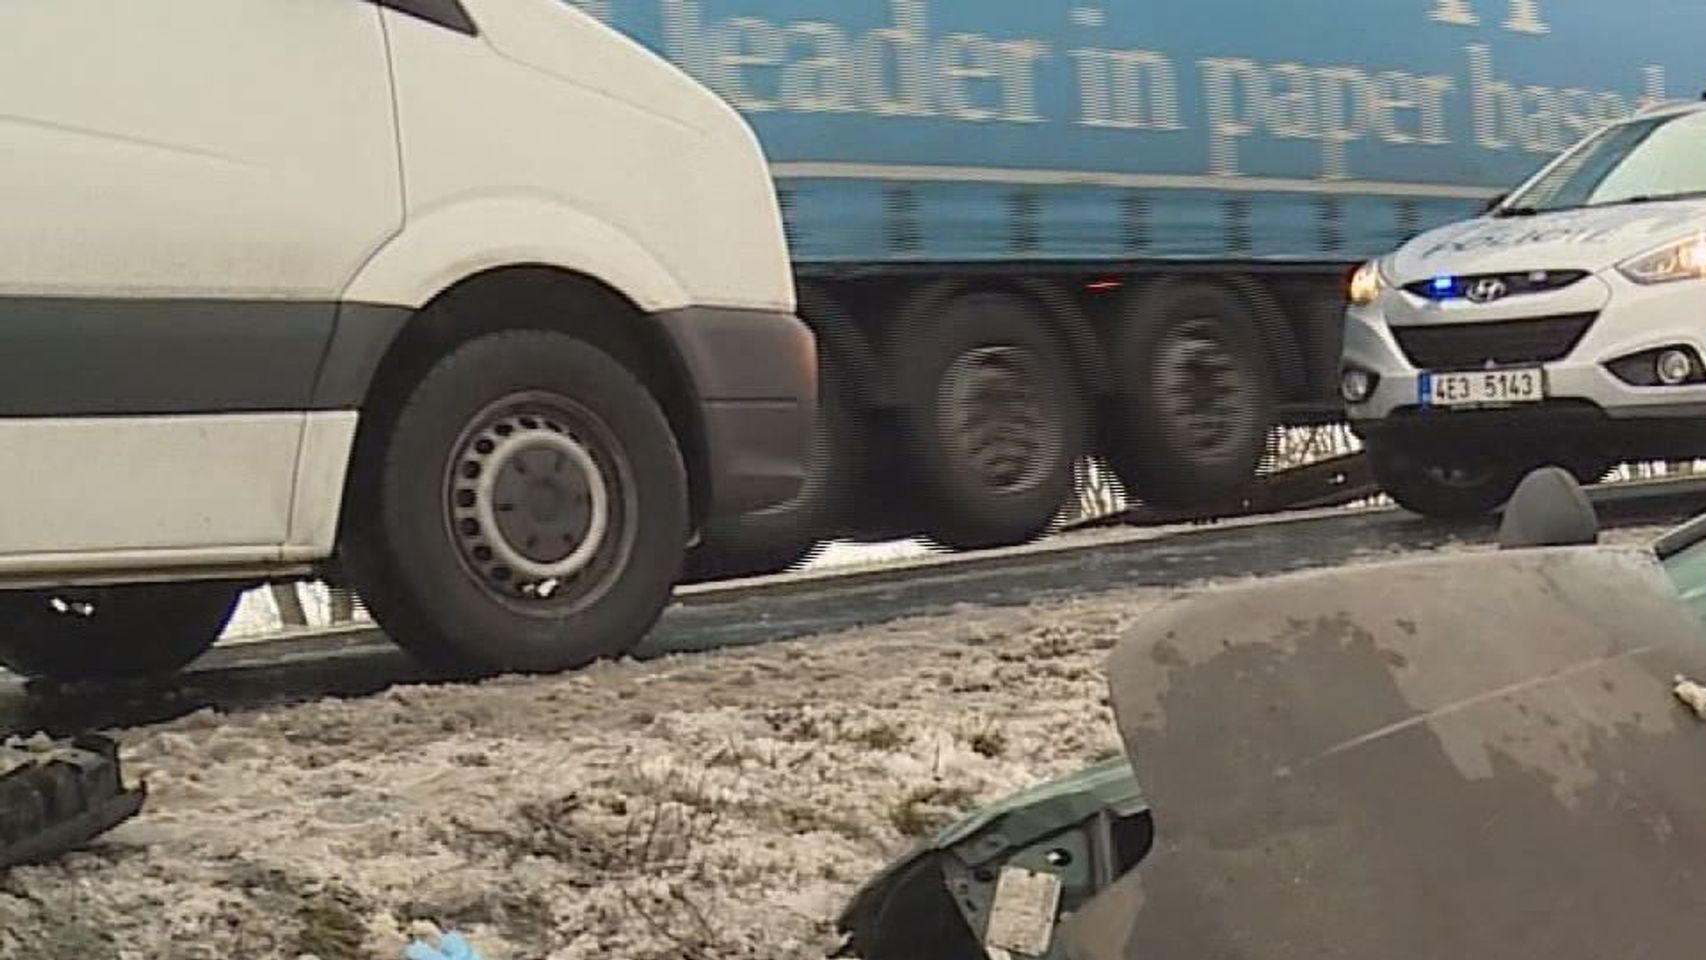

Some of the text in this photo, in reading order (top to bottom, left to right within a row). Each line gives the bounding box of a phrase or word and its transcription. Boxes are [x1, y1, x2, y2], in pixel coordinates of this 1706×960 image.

[1070, 8, 1186, 130] in
[1196, 57, 1457, 180] paper
[1436, 373, 1533, 399] 4E3 5143
